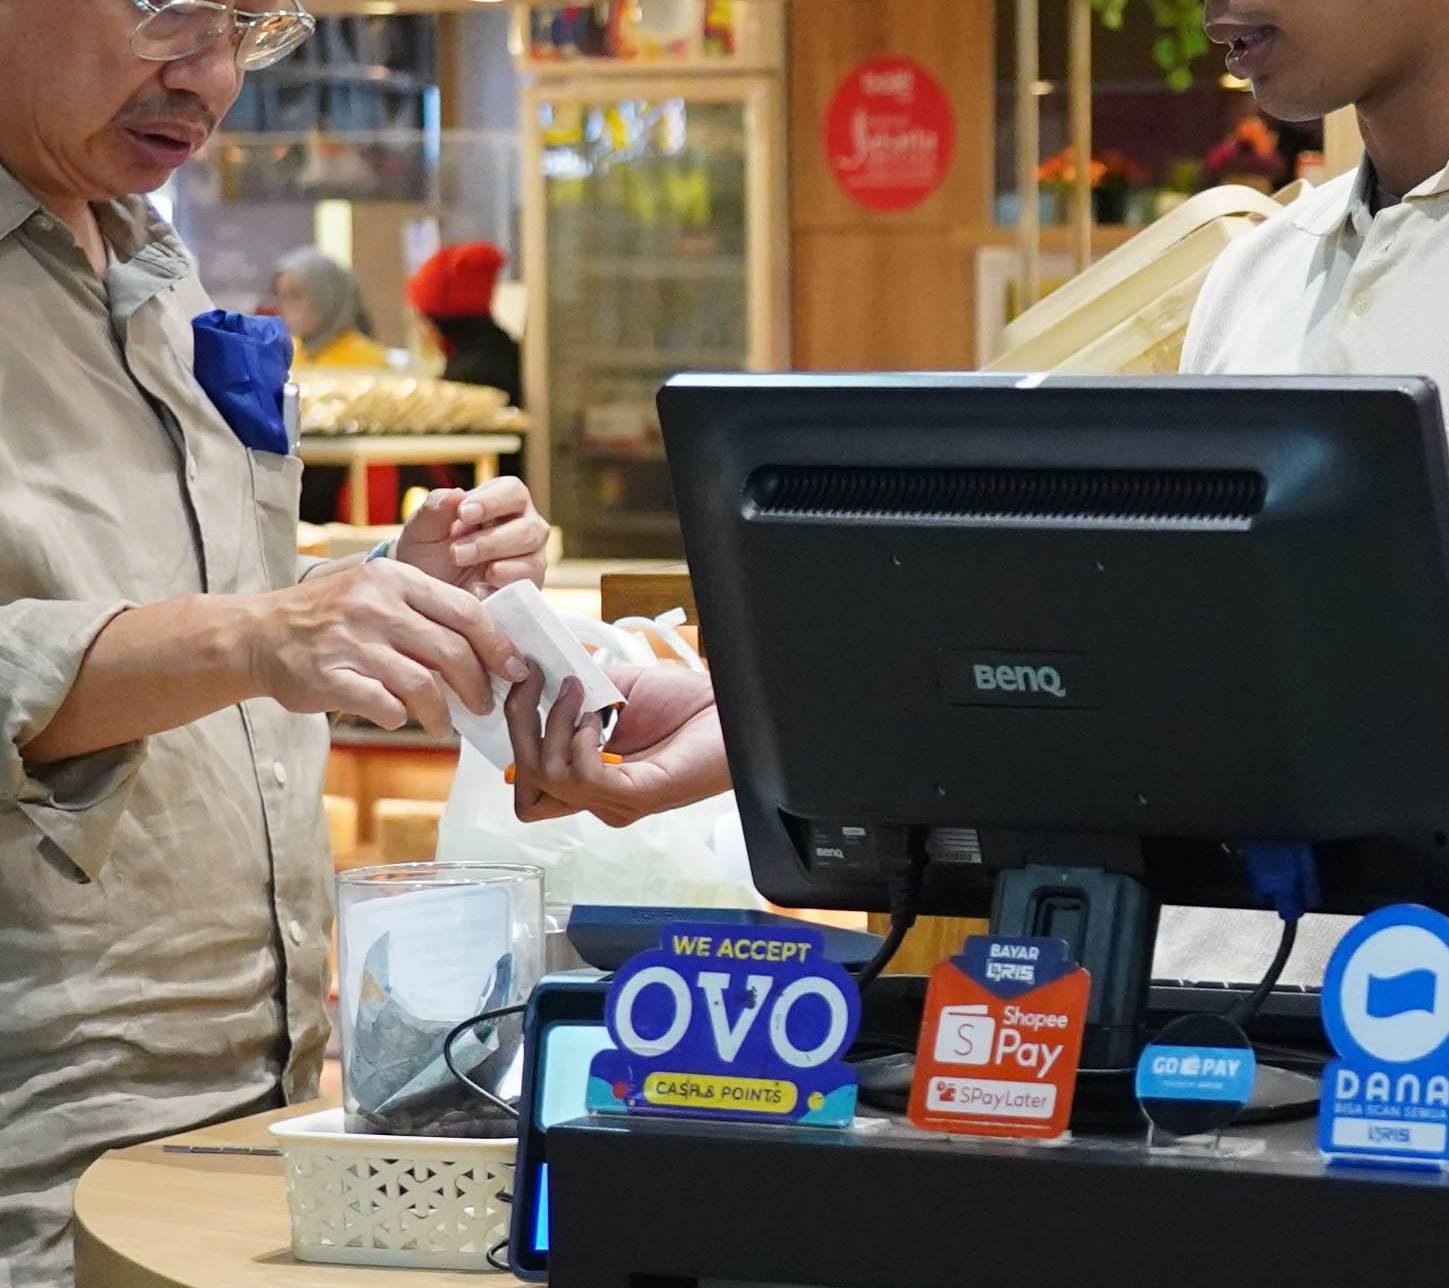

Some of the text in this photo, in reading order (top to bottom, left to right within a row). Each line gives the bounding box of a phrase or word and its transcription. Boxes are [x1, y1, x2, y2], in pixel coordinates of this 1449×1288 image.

[973, 664, 1067, 697] BenQ
[672, 935, 812, 962] WE ACCEPT
[989, 943, 1040, 961] BAYAR
[985, 960, 1036, 984] QRIS
[615, 966, 849, 1068] OVO
[1003, 1006, 1068, 1032] Shopee
[995, 1028, 1064, 1078] Pay
[1153, 1056, 1241, 1076] GO PAY
[656, 1081, 701, 1098] CASH
[722, 1087, 782, 1103] POINTS
[960, 1086, 1049, 1110] SPayLater
